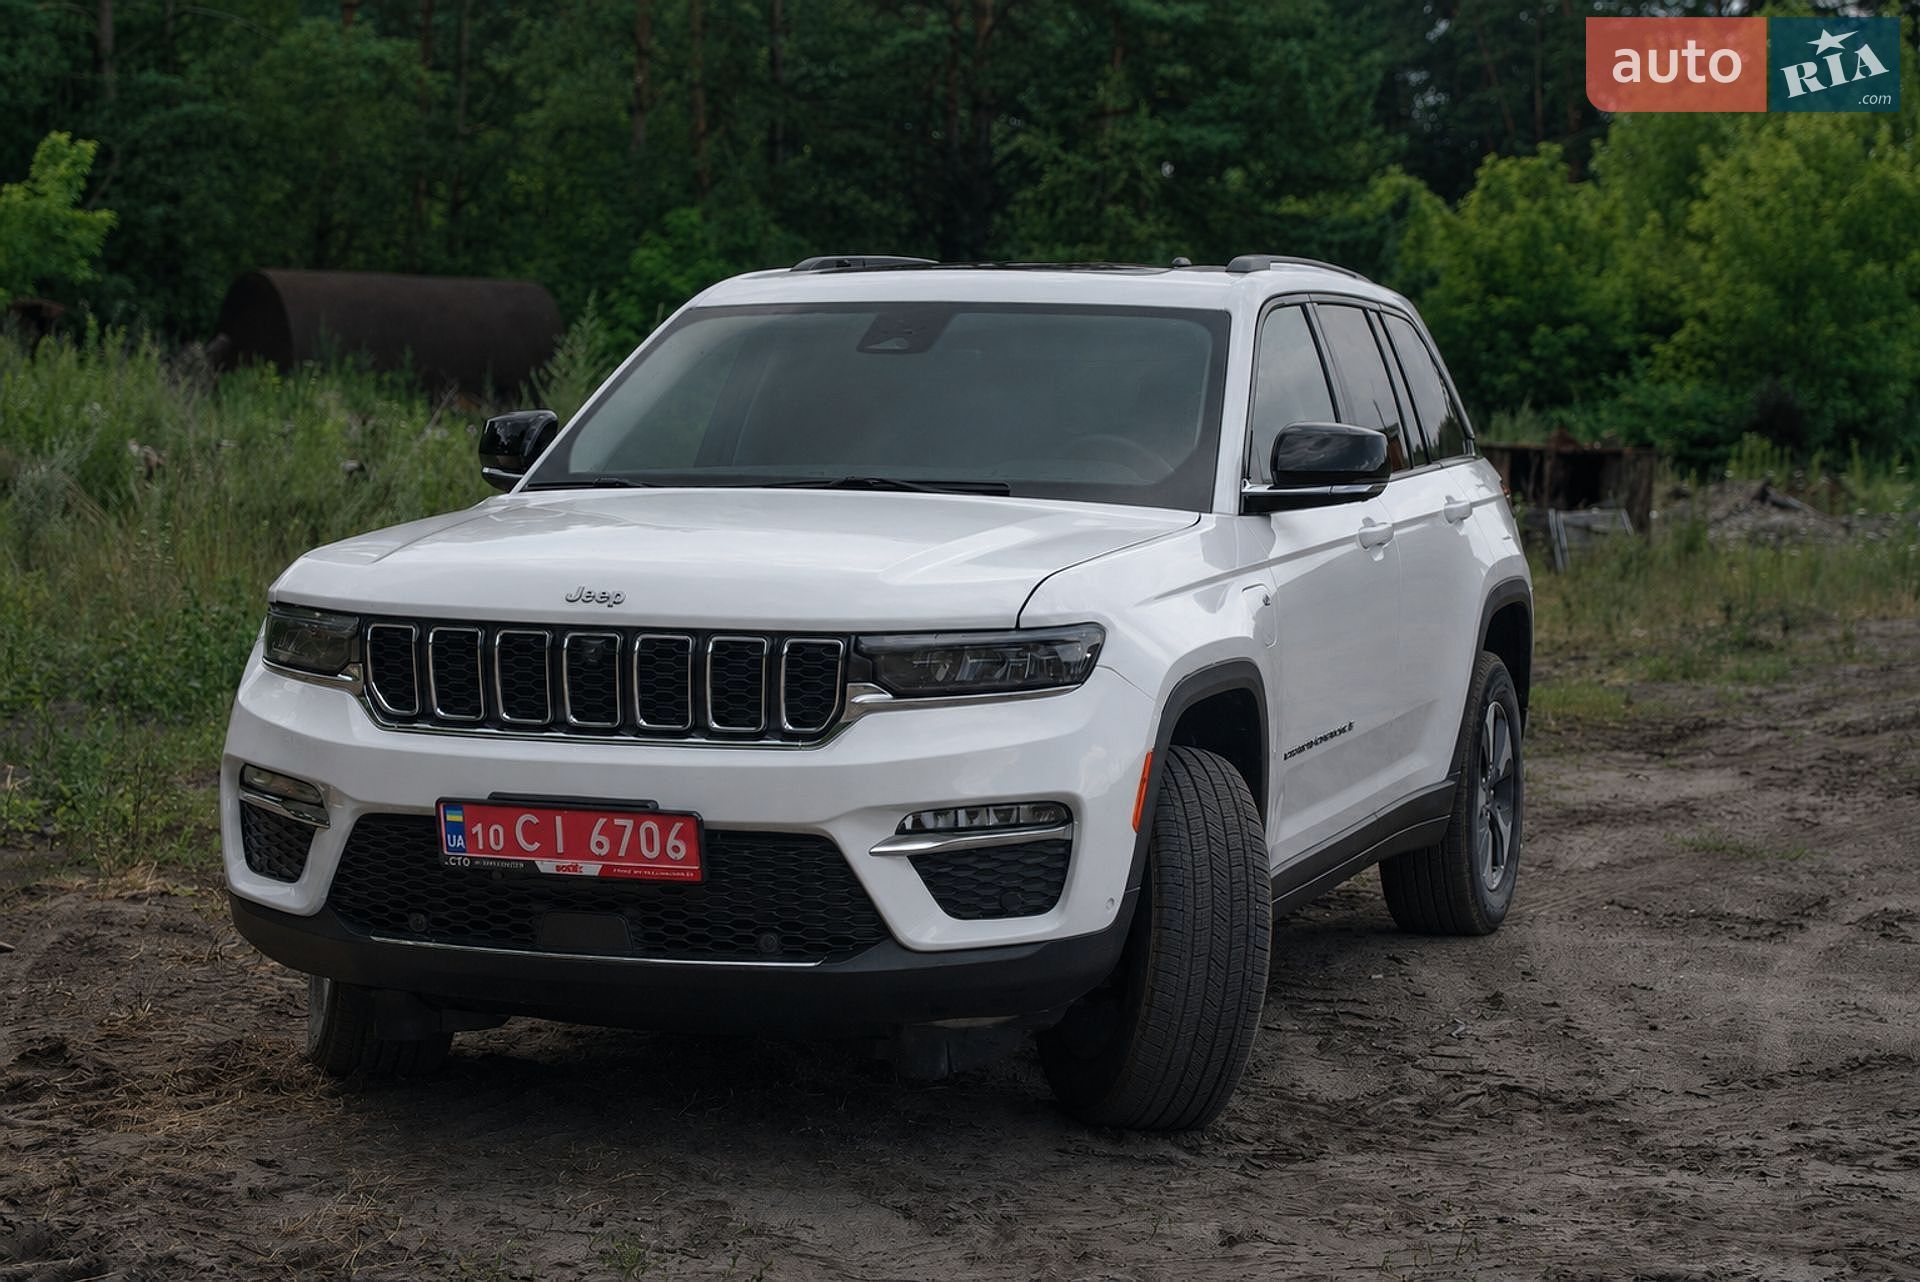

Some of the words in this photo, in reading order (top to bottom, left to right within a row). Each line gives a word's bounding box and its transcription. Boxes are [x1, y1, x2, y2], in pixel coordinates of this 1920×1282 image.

[565, 585, 627, 608] Jeep
[447, 834, 465, 849] UA
[471, 823, 504, 851] 10
[515, 814, 563, 854] CI
[589, 817, 687, 861] 6706
